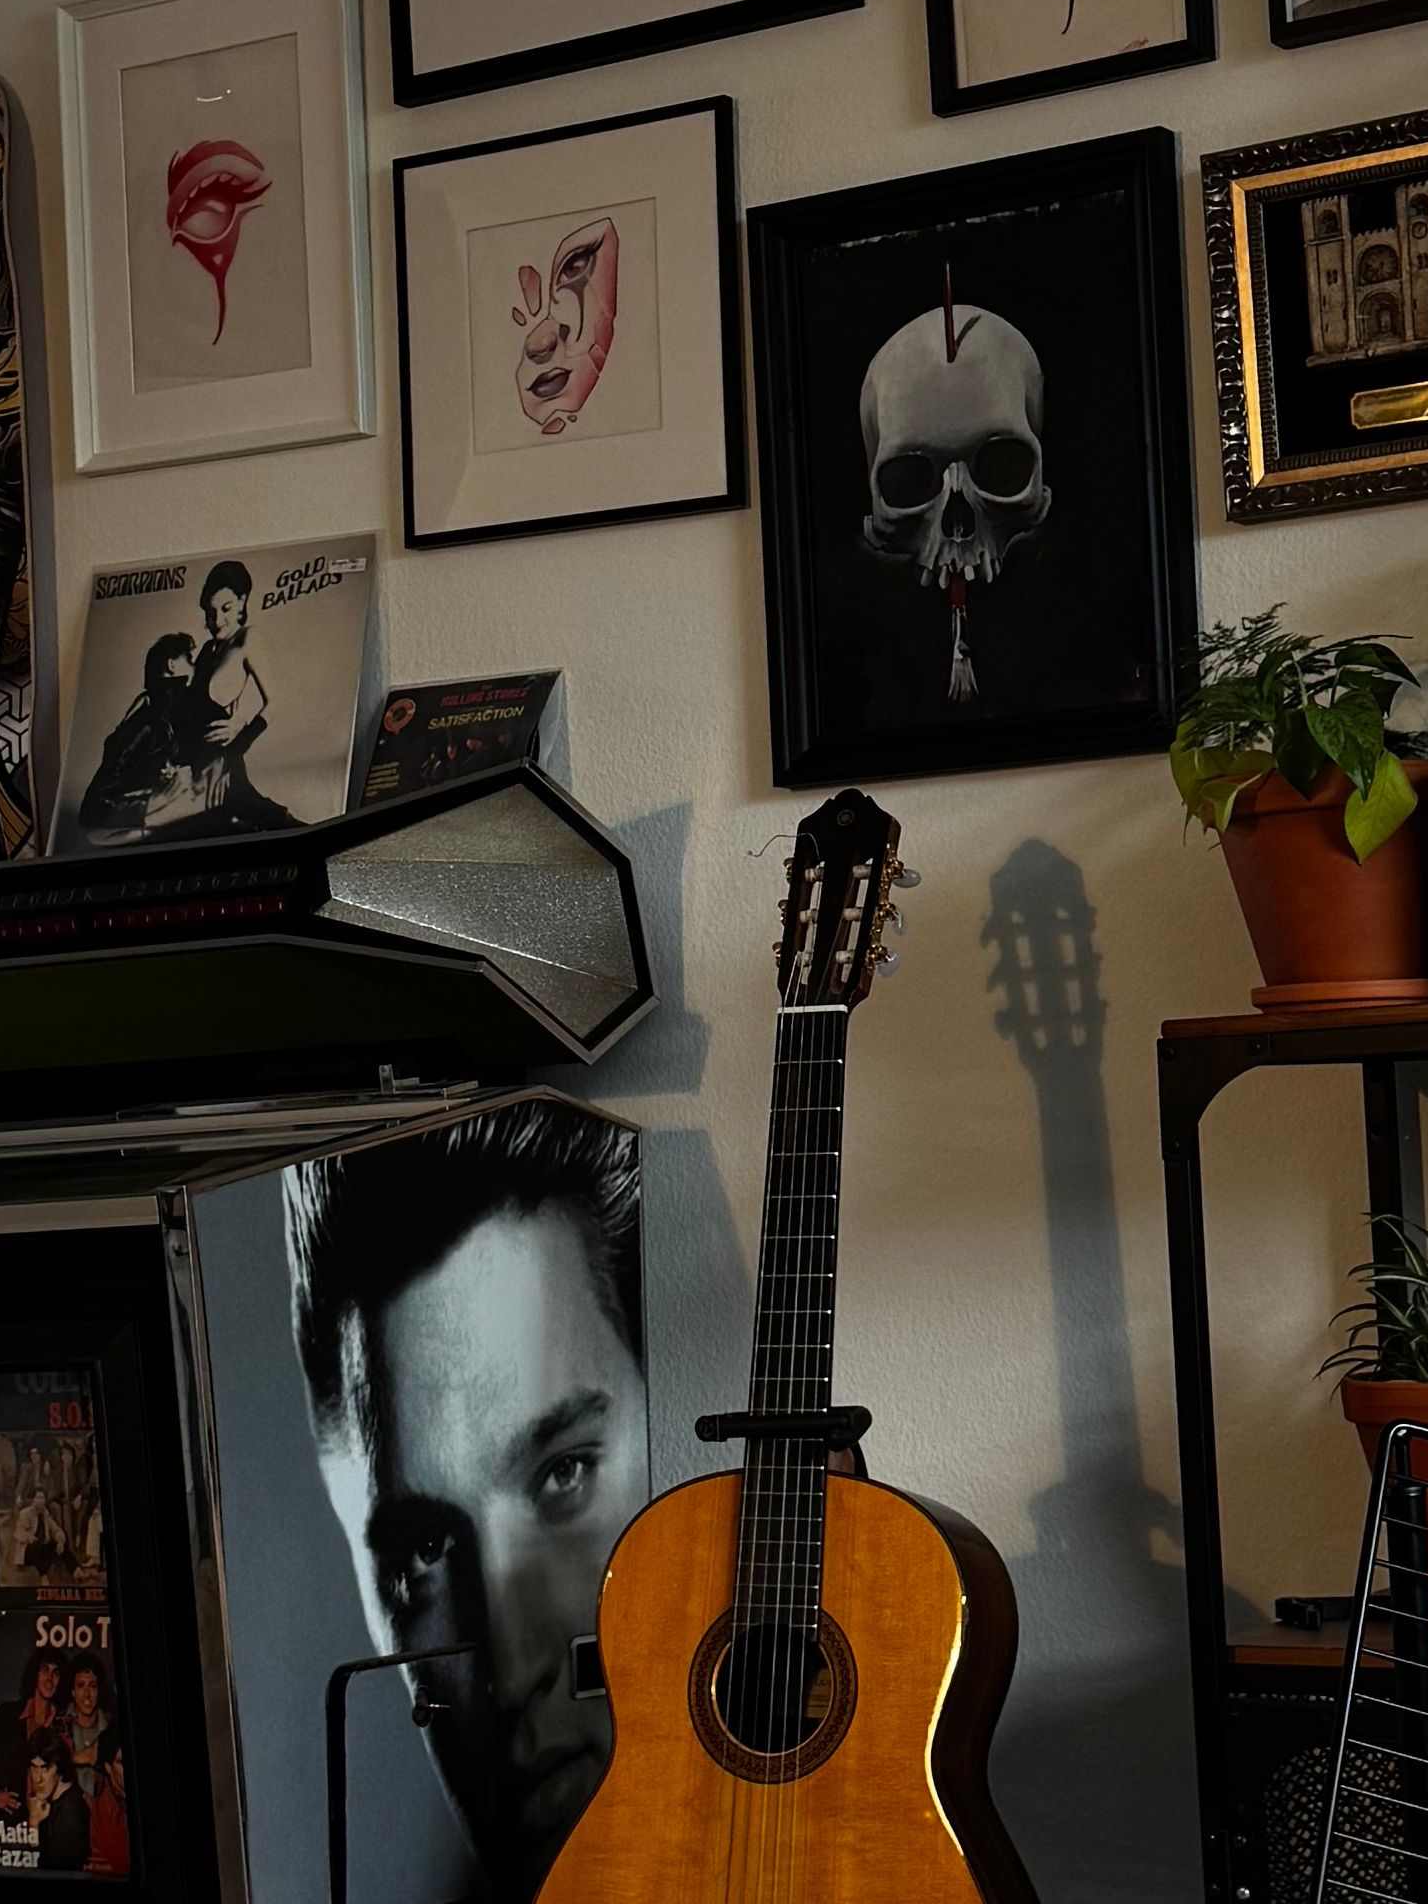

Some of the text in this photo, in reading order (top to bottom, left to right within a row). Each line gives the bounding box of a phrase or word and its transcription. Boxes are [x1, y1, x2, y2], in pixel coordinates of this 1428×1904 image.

[95, 566, 186, 599] SCORPIONS
[262, 573, 342, 610] BALLADS
[427, 706, 524, 730] SATISFACTION
[35, 1615, 92, 1649] Solo
